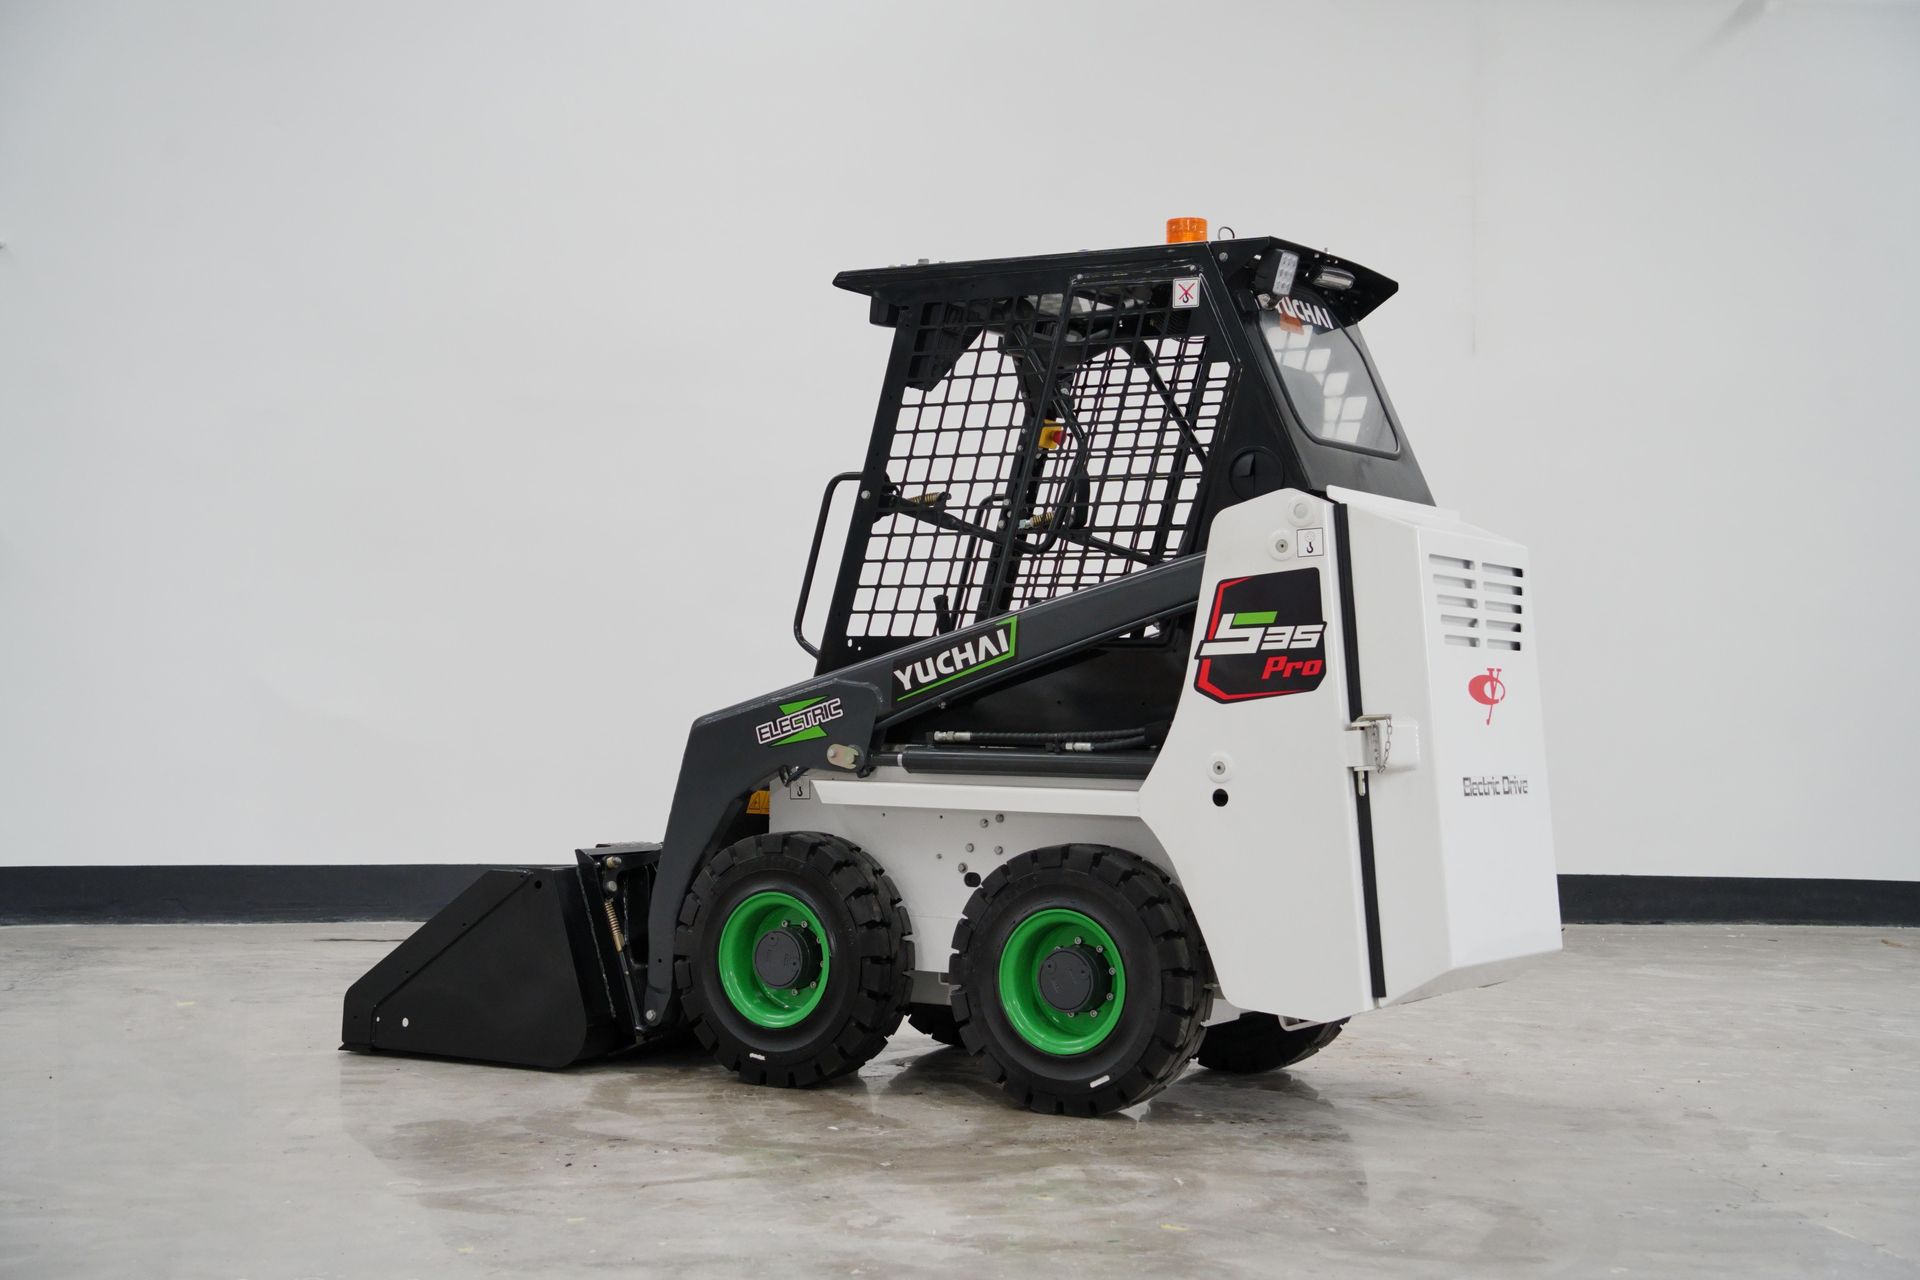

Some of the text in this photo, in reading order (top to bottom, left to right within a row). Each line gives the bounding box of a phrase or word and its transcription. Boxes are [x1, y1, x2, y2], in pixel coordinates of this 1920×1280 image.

[1200, 611, 1324, 656] S35
[893, 629, 1009, 691] YUCHAI
[1261, 655, 1322, 680] Pro
[756, 698, 843, 744] ELECTRIC
[1462, 775, 1528, 797] Electric Drive
